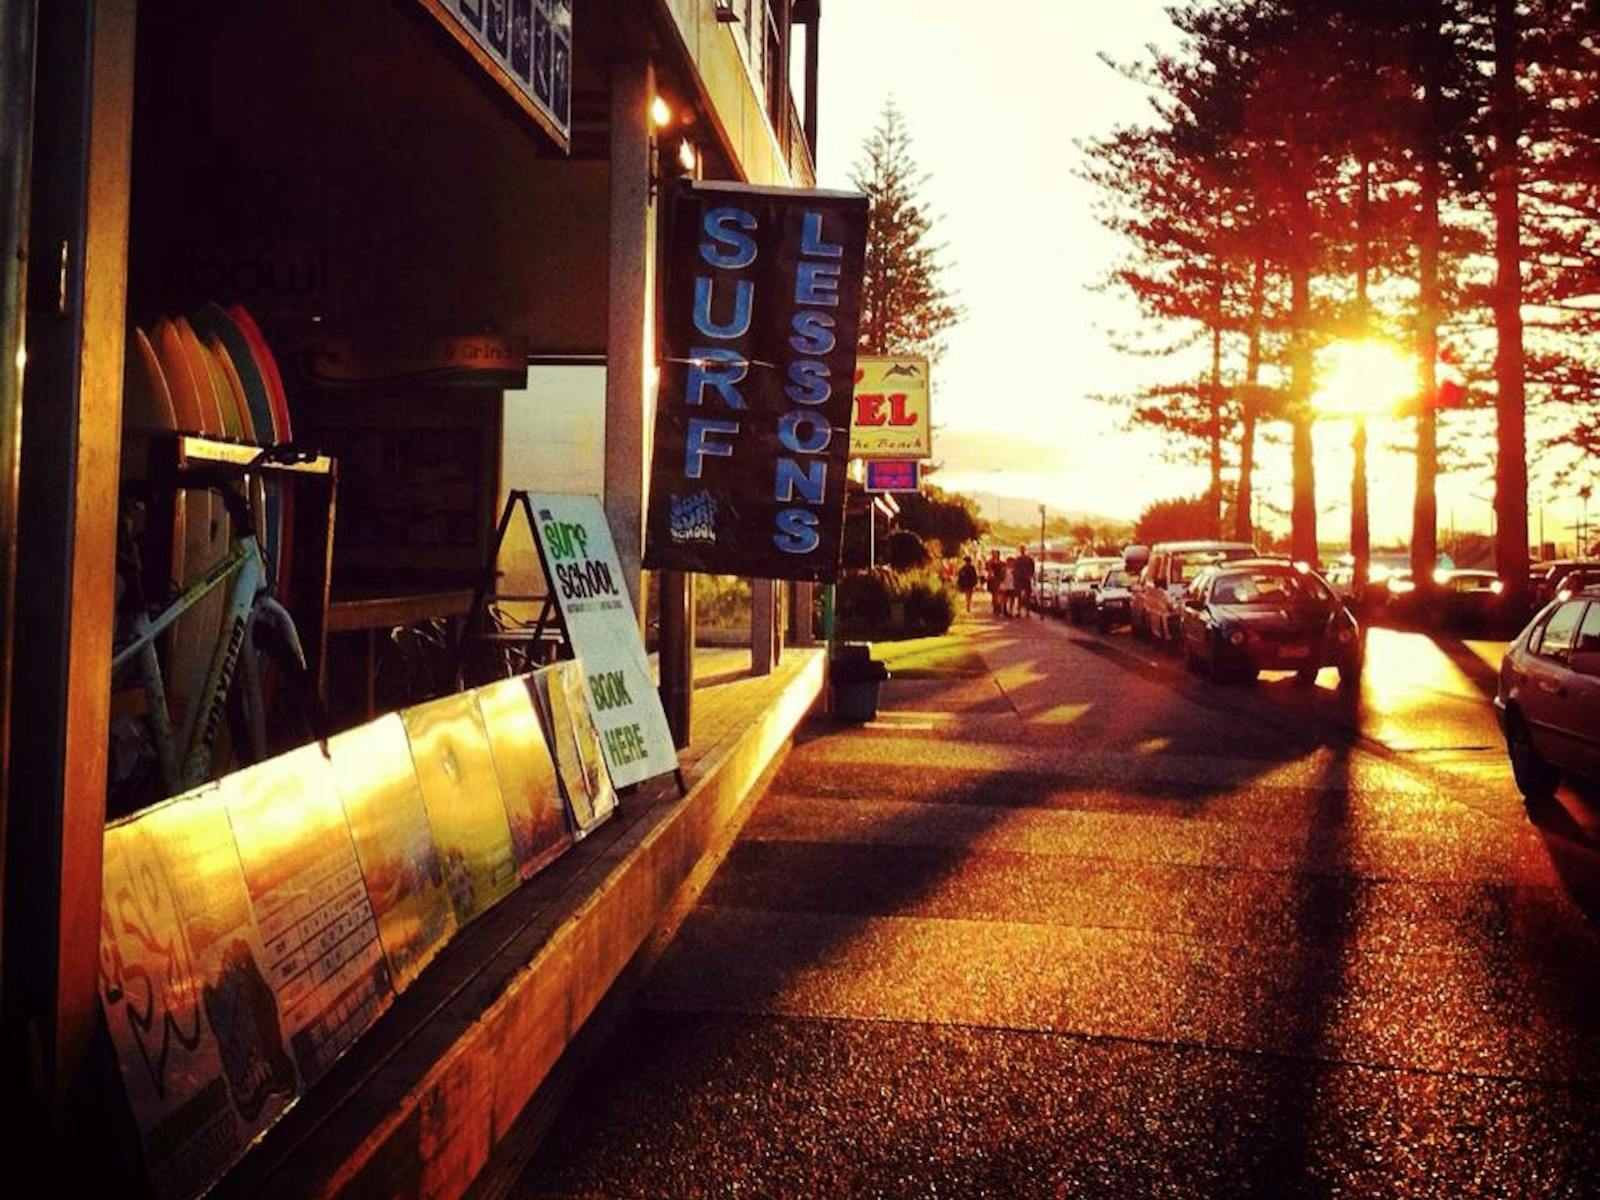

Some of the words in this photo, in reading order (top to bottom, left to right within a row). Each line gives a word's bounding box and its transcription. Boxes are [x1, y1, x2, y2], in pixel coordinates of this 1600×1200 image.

[685, 207, 758, 479] SURF
[774, 209, 843, 553] LESSONS
[589, 671, 632, 712] BOOK
[606, 725, 648, 768] HERE
